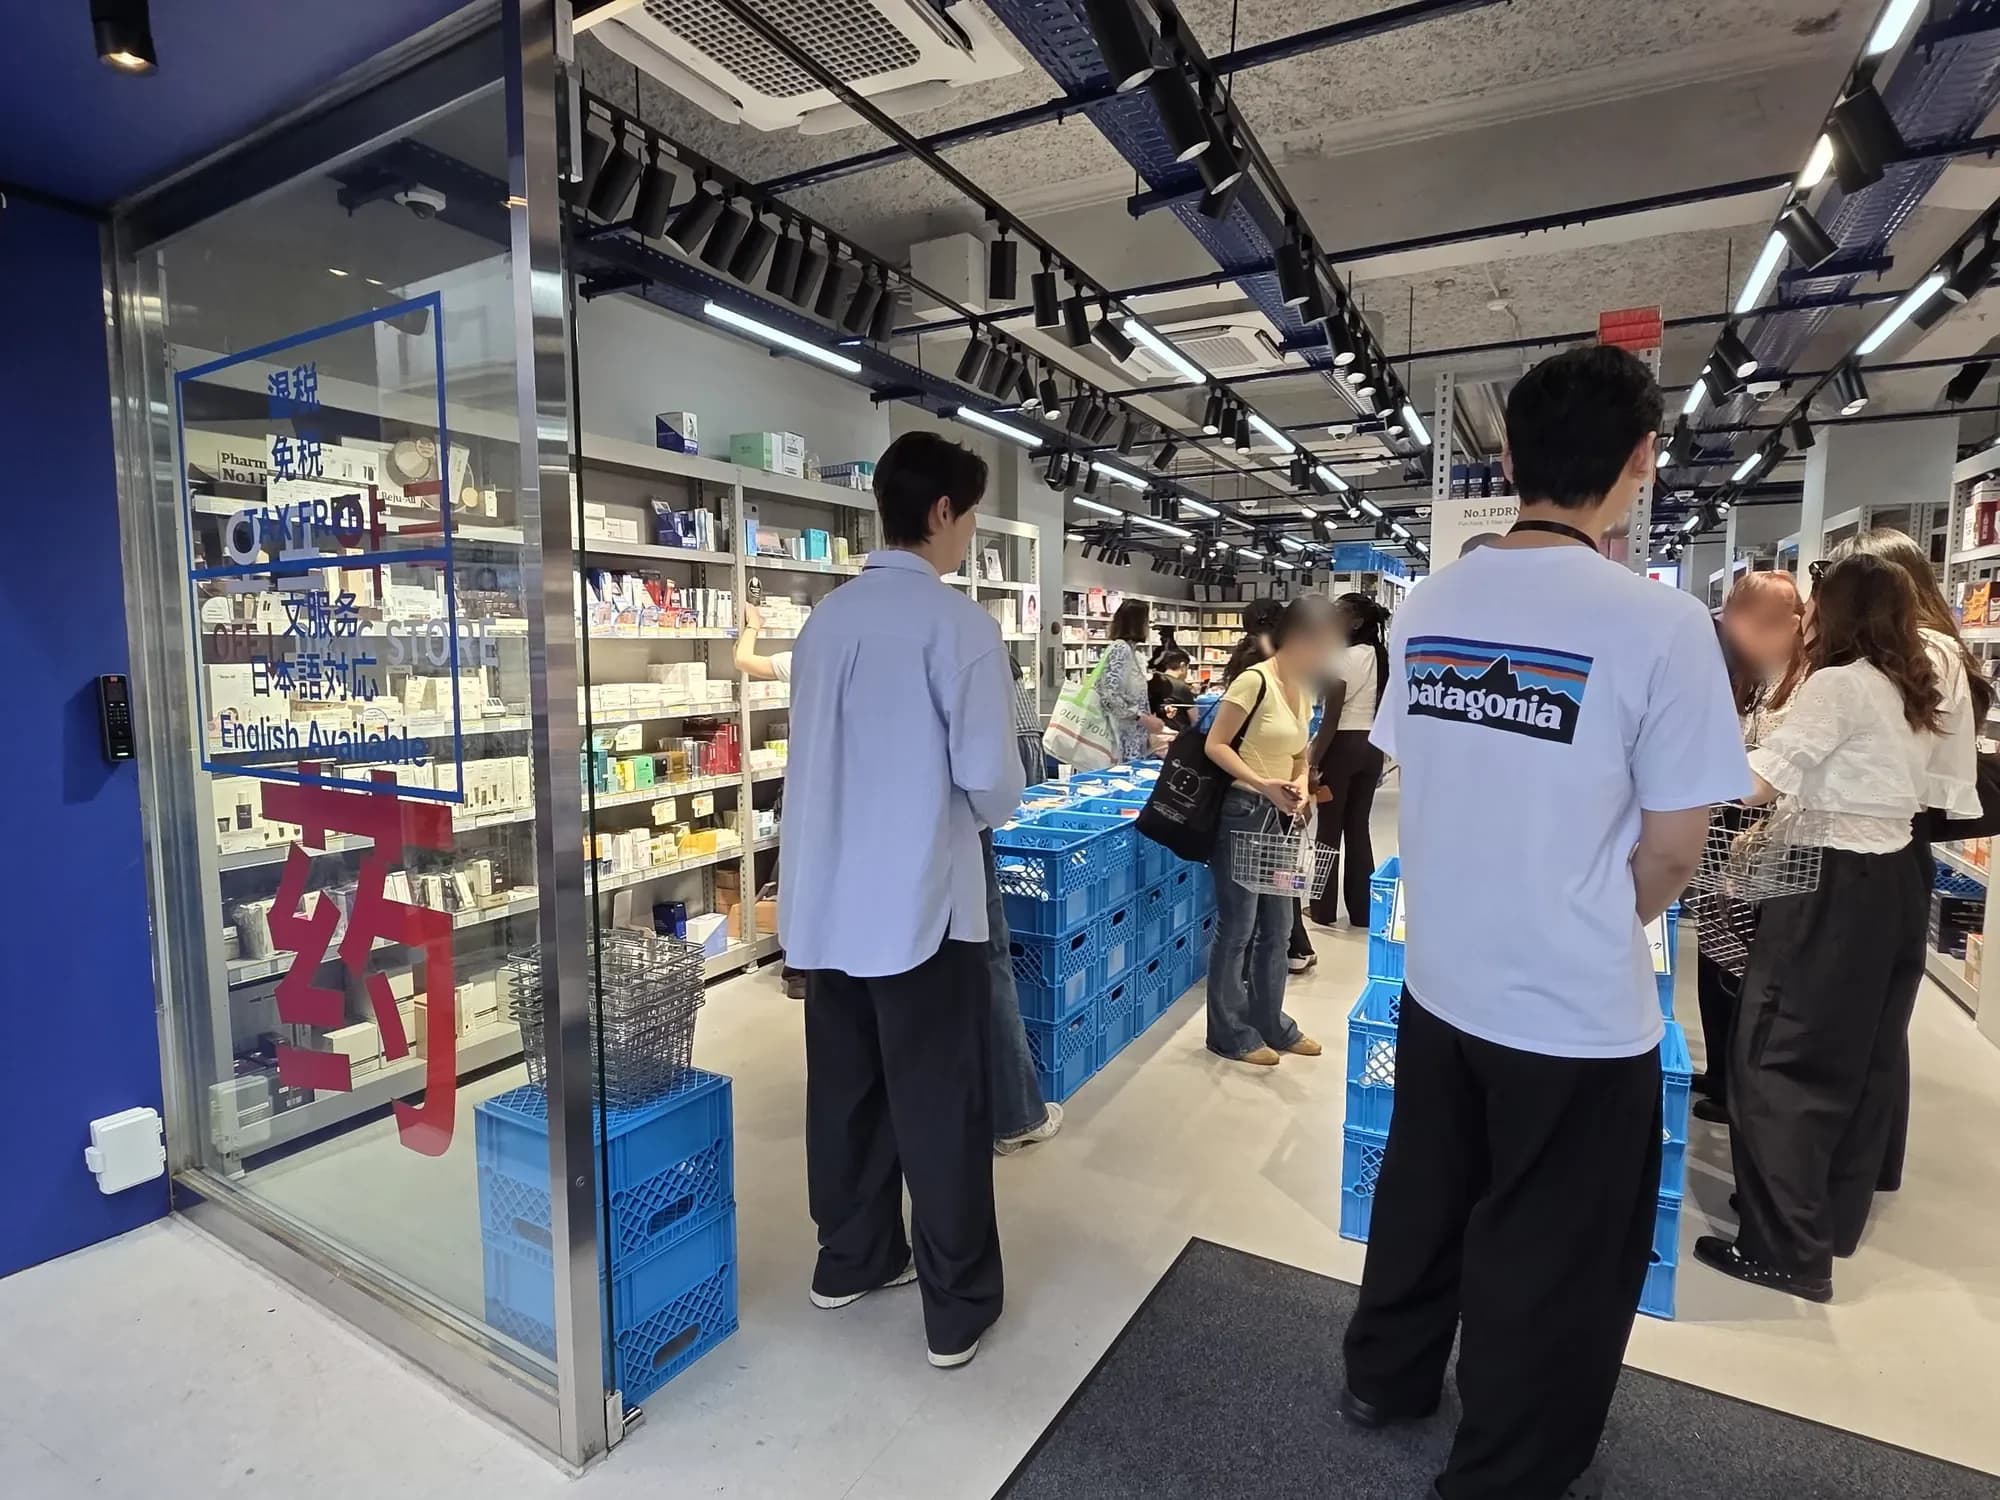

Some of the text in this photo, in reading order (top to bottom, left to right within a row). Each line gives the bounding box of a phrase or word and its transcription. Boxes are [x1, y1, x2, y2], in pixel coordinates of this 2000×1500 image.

[221, 452, 268, 469] Pharm
[222, 467, 257, 484] No.1
[271, 431, 324, 485] 免税
[243, 503, 293, 544] TAX
[1464, 508, 1487, 519] No.1
[385, 615, 499, 667] STORE
[250, 651, 380, 702] 日本語対応
[220, 712, 428, 767] English Available
